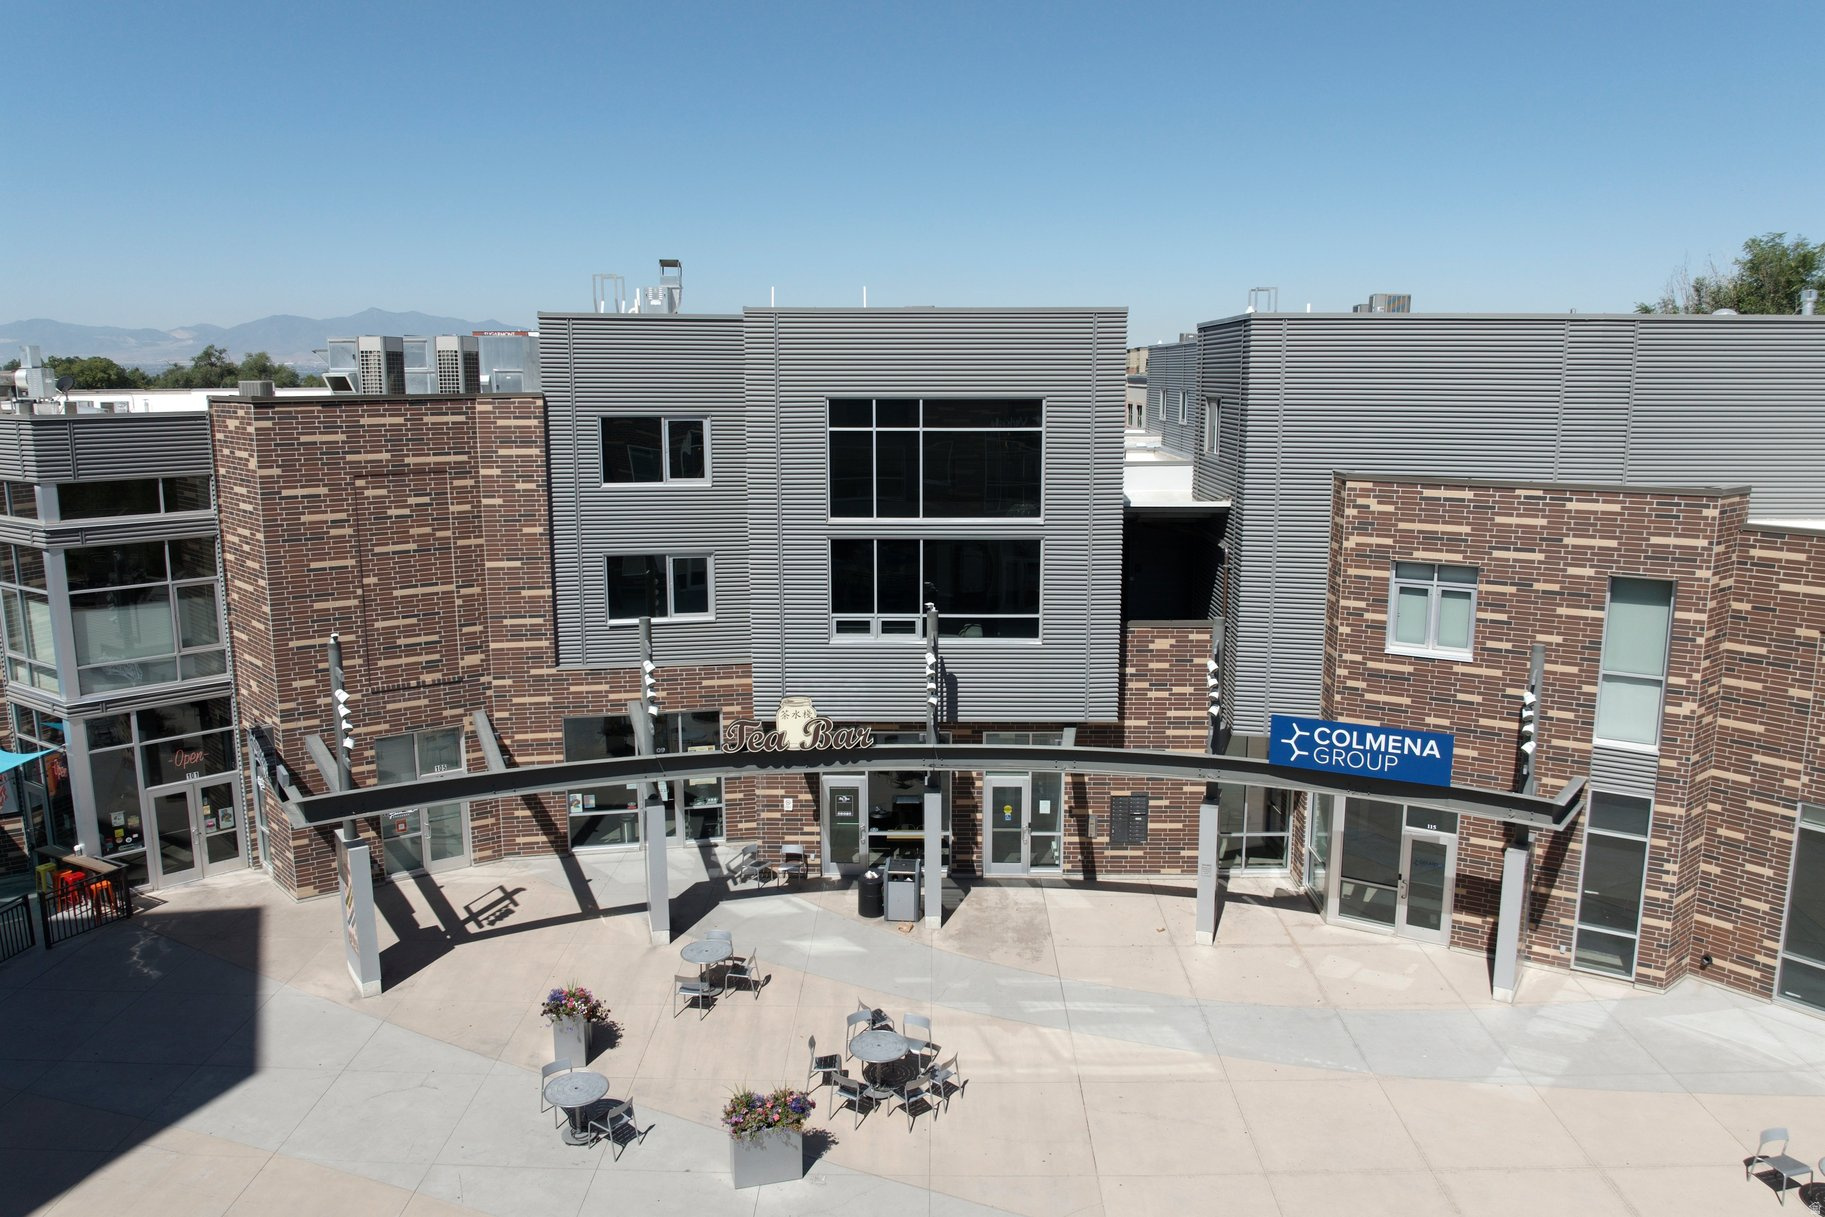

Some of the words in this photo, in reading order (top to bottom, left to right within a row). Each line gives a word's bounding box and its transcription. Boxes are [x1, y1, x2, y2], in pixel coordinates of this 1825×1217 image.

[722, 719, 790, 753] Tea
[799, 716, 874, 751] Bar
[1313, 727, 1441, 759] COLMENA
[1313, 747, 1399, 772] GROUP
[186, 771, 199, 780] 101
